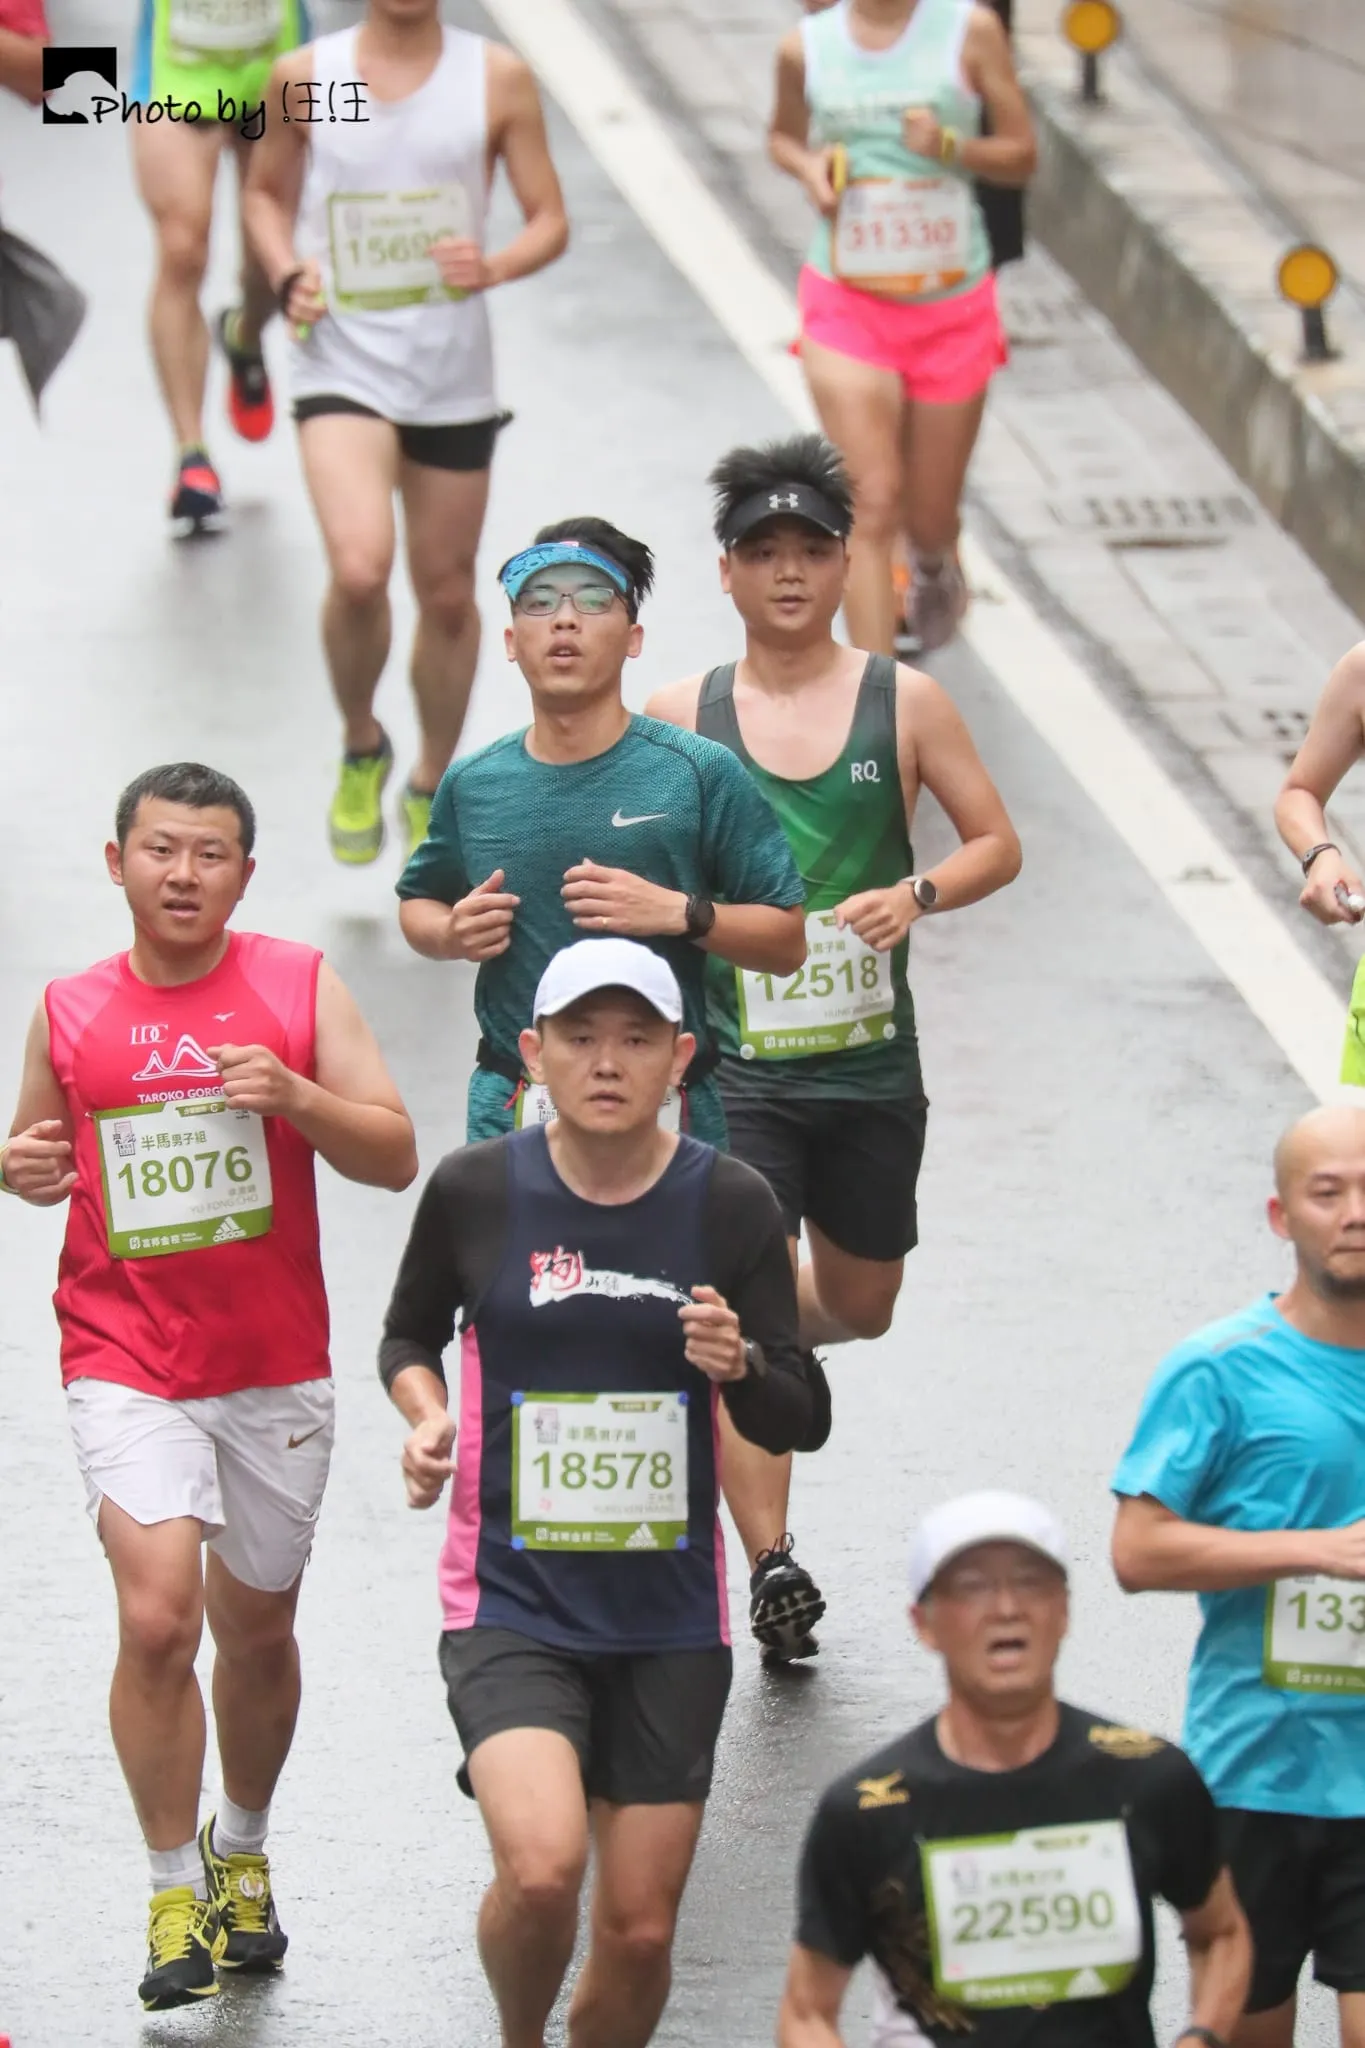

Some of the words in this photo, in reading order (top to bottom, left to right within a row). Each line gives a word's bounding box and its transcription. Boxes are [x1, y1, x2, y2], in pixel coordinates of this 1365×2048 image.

[850, 760, 880, 784] RQ
[754, 954, 879, 1002] 12518
[137, 1089, 185, 1105] TAROKO
[140, 1130, 207, 1151] 半馬男子組
[117, 1145, 253, 1200] 18076
[532, 1450, 674, 1490] 18578
[1287, 1590, 1365, 1635] 133
[953, 1888, 1115, 1945] 22590
